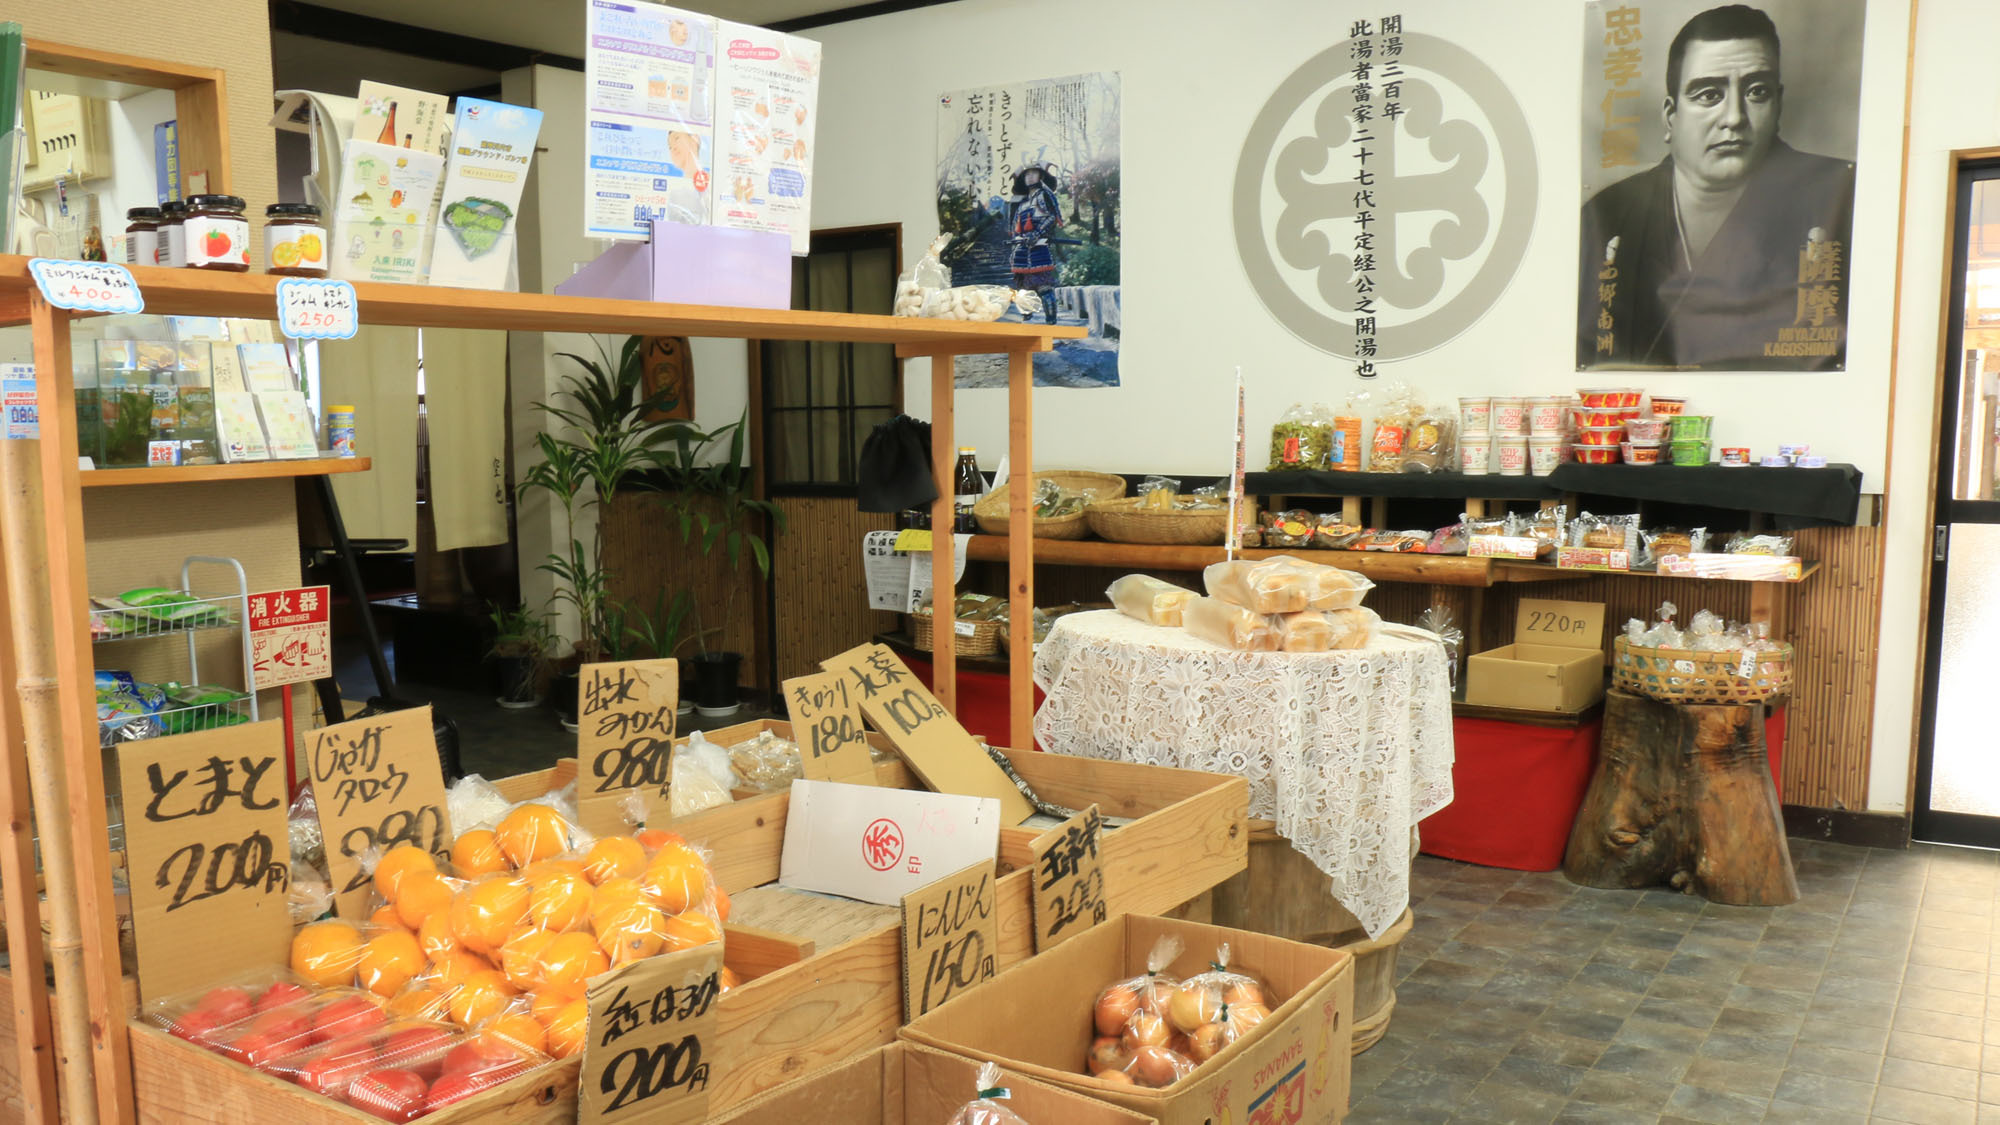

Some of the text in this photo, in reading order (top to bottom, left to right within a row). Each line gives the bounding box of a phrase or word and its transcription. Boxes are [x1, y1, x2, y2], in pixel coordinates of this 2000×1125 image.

[1380, 14, 1405, 121] 開湯三百年
[967, 94, 983, 199] 忘れない心
[46, 269, 100, 280] ミルクジャム
[1764, 342, 1837, 357] KAGOSHIMA
[1778, 328, 1838, 341] MIYAZAKI
[250, 591, 319, 618] 消火器
[258, 613, 310, 627] FIRE EXTINGUISHER
[1527, 611, 1586, 634] 220円
[794, 678, 849, 718] きゅうり
[848, 651, 908, 699] 水菜
[596, 706, 674, 740] みかん
[811, 714, 865, 758] 180円
[883, 688, 947, 735] 100円
[315, 725, 392, 782] じゃが
[593, 737, 671, 801] 280円
[145, 756, 280, 822] とまと
[333, 763, 409, 817] タロウ
[155, 830, 288, 912] 200円
[866, 825, 900, 867] 秀
[917, 873, 992, 949] にんじん
[1047, 867, 1107, 938] 200円
[920, 930, 995, 1016] 150円
[601, 971, 720, 1047] 紅はるか
[600, 1034, 710, 1115] 200円
